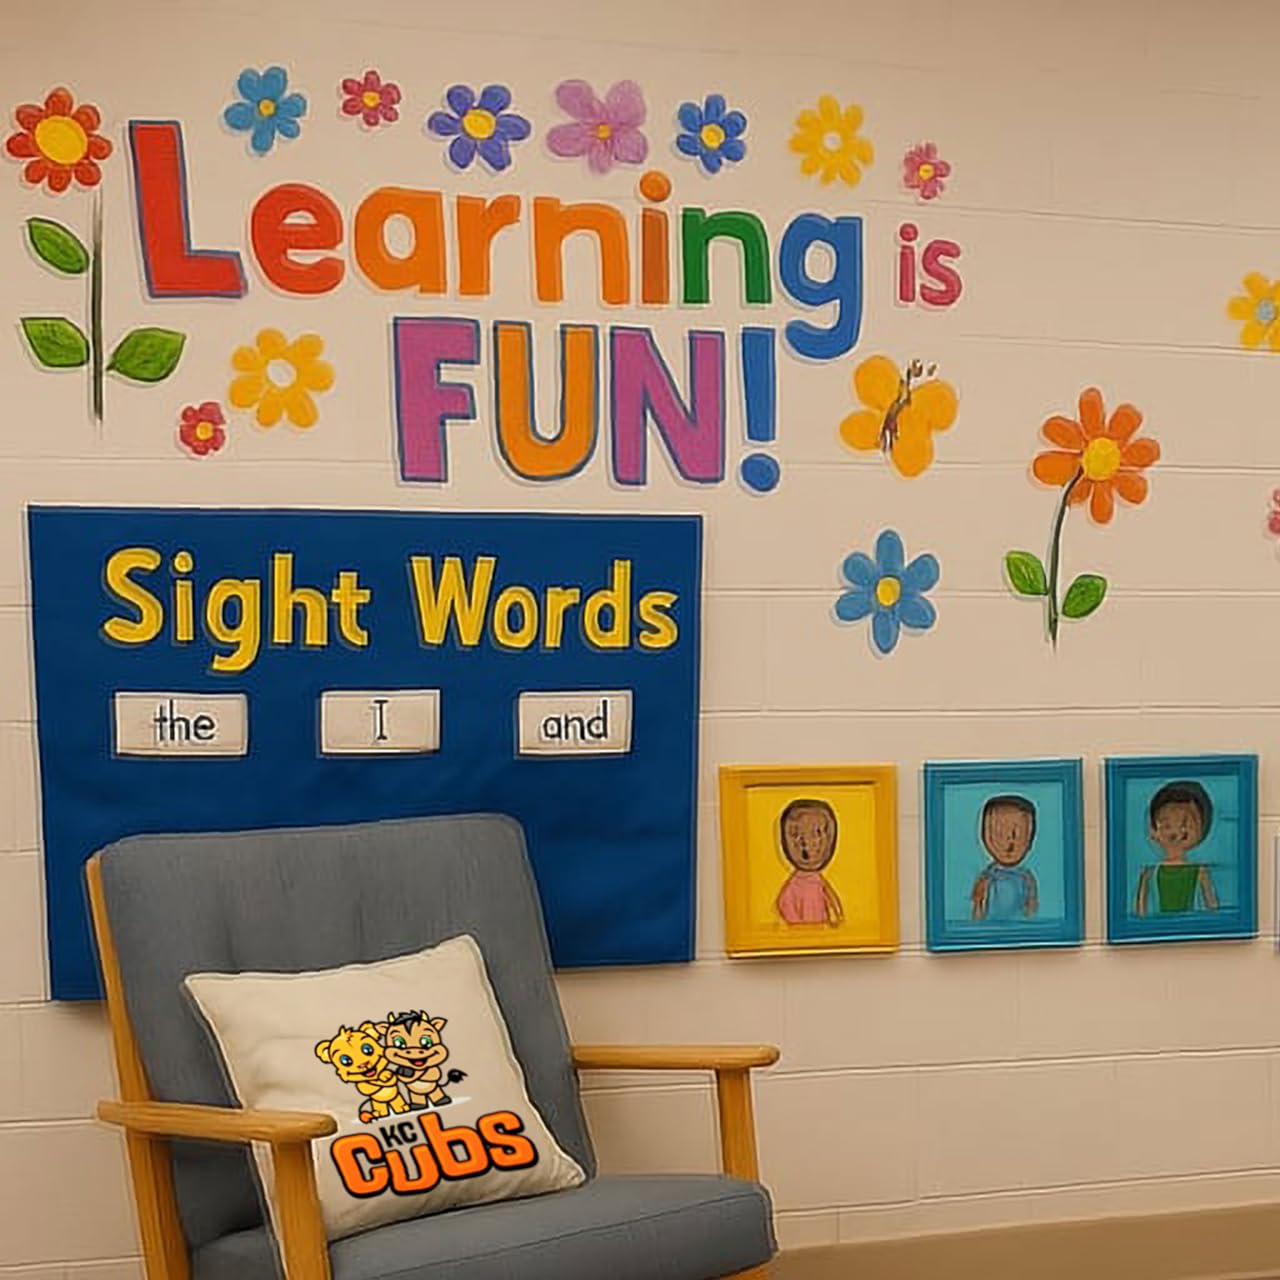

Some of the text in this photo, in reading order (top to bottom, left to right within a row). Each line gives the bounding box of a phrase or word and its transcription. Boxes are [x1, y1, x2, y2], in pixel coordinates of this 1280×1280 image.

[129, 120, 961, 359] Learning is
[393, 316, 781, 493] FUN!
[101, 547, 678, 674] Sight Words
[154, 700, 216, 742] the
[373, 700, 389, 741] I
[542, 700, 608, 742] and
[381, 1122, 418, 1147] KC
